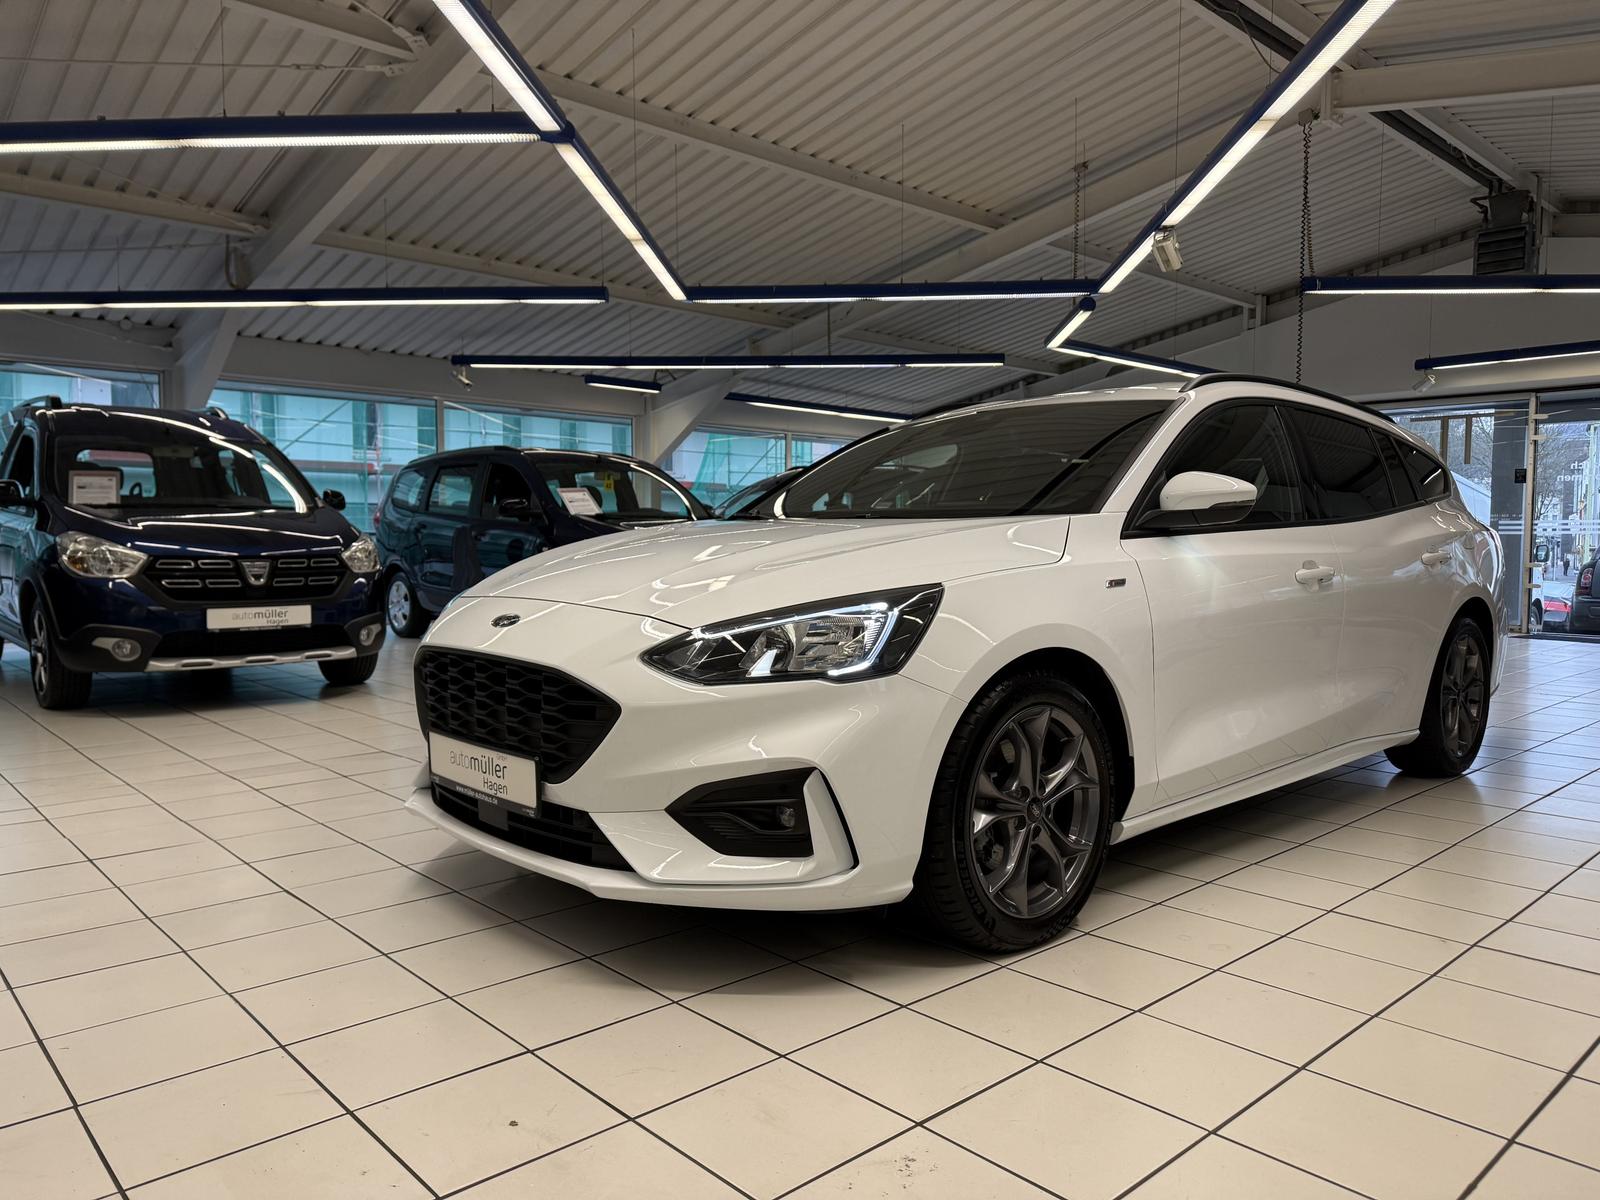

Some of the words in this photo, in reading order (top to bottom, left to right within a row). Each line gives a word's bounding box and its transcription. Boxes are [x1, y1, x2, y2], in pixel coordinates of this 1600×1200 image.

[232, 609, 288, 621] automüller
[450, 751, 507, 780] automüller
[483, 778, 508, 796] Hagen
